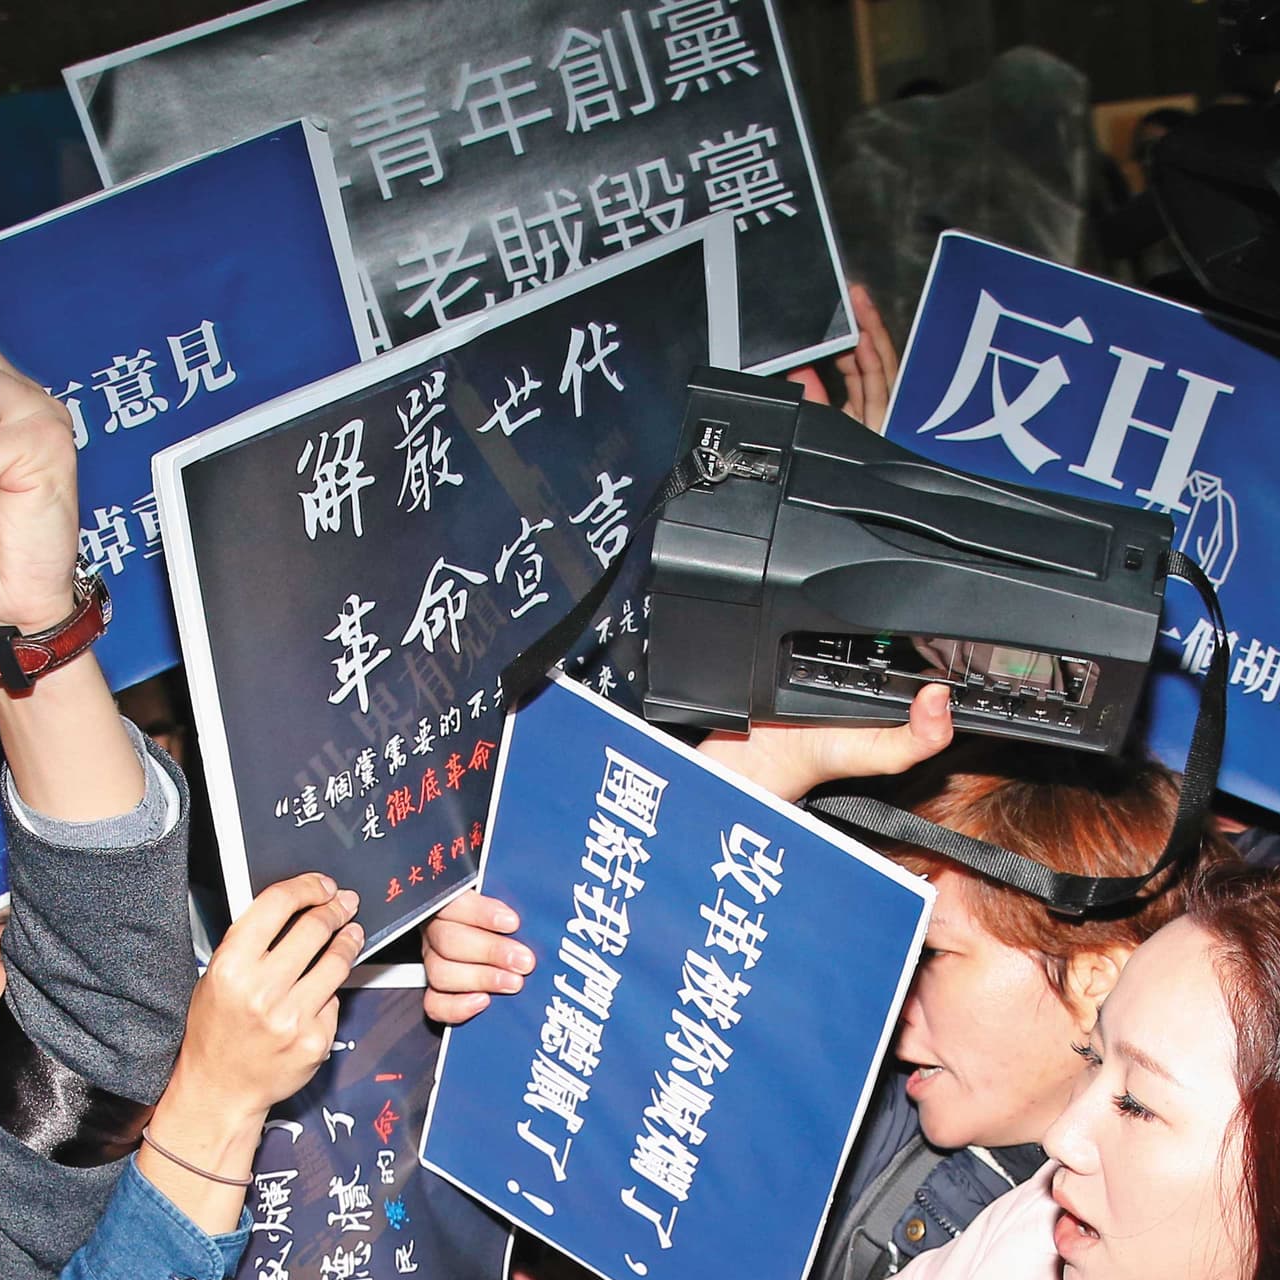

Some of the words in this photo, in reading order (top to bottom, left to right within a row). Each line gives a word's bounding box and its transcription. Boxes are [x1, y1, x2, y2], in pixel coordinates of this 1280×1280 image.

[339, 0, 761, 202] 青年創黨
[357, 123, 800, 353] 老賊毀黨
[296, 320, 626, 541] 解嚴世代
[917, 287, 1237, 516] 反H
[506, 745, 670, 1218] 團結我們聽膩了！
[620, 821, 789, 1277] 改革被你喊爛了，
